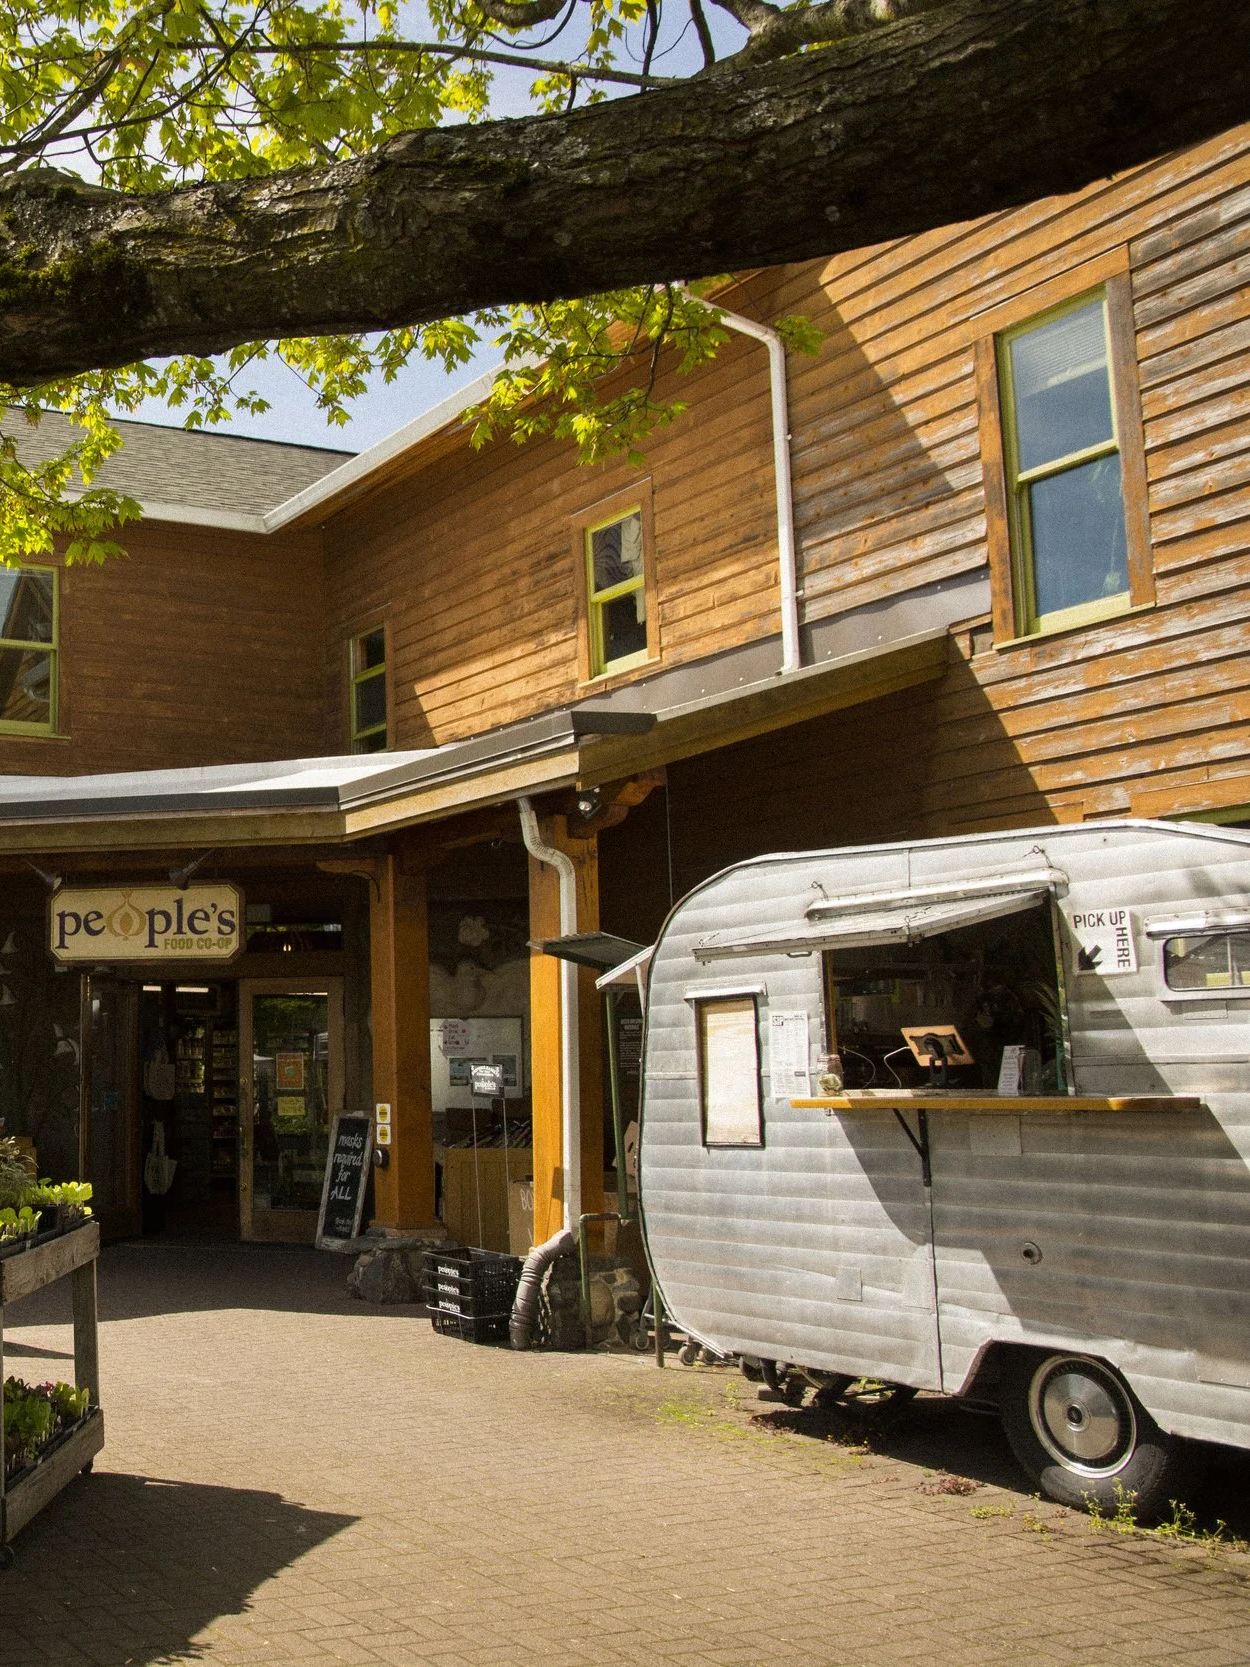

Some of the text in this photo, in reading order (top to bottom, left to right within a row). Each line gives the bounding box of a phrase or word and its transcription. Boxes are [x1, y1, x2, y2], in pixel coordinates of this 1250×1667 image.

[56, 894, 236, 950] people's
[1073, 910, 1126, 929] PICK UP
[164, 937, 233, 950] FOOD CO-OP
[1115, 927, 1131, 968] HERE
[338, 1132, 363, 1149] masks
[335, 1167, 351, 1182] for
[330, 1185, 352, 1201] ALL
